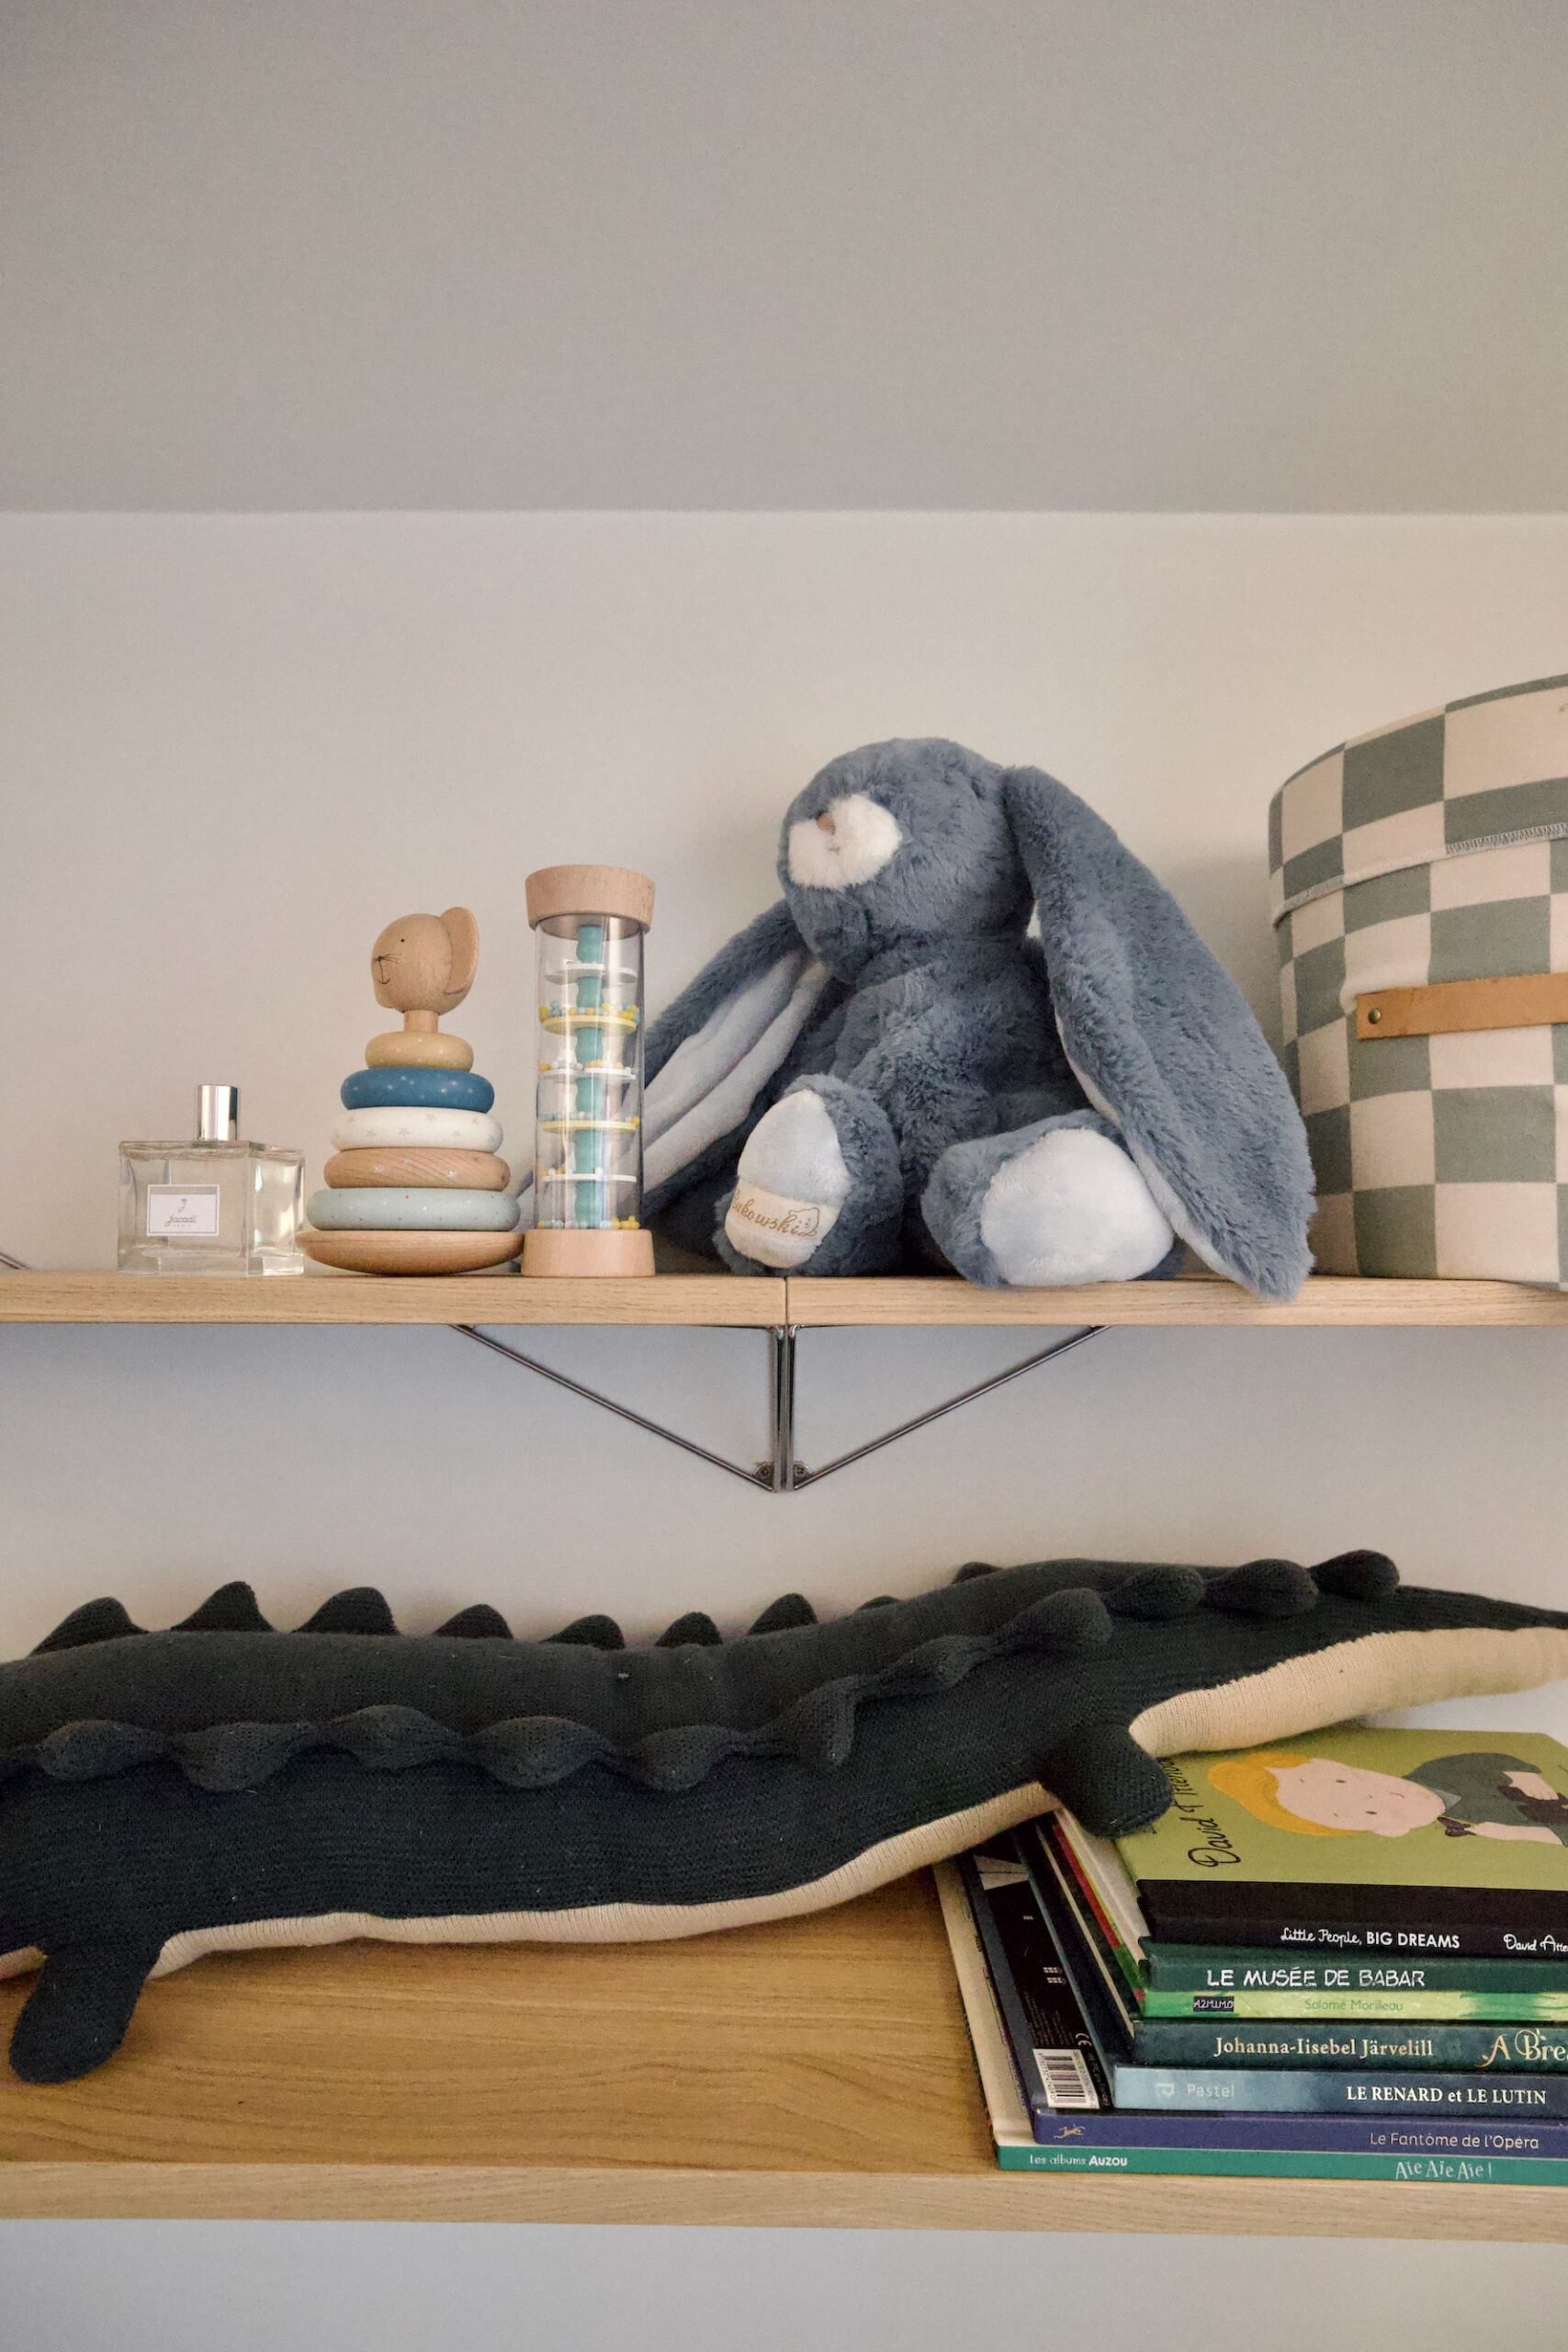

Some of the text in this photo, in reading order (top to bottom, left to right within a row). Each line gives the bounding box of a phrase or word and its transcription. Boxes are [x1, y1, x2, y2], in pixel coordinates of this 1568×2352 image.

[1179, 1817, 1241, 1867] David
[1280, 1927, 1461, 1950] Little People, BIG DREAMS
[1503, 1933, 1538, 1951] David
[1206, 1966, 1426, 1987] LE MUSÉE DE BABAR
[1304, 1997, 1404, 2012] Salomé Morilleau
[1359, 2039, 1434, 2060] Järvelill
[1474, 2028, 1568, 2067] A Bre
[1187, 2083, 1235, 2098] Pastel
[1347, 2086, 1547, 2105] LE RENARD et LE LUTIN
[1370, 2132, 1386, 2145] Le
[1391, 2132, 1458, 2147] Fantôme
[1461, 2134, 1481, 2147] de
[1030, 2154, 1046, 2165] Les
[1049, 2154, 1087, 2165] albums
